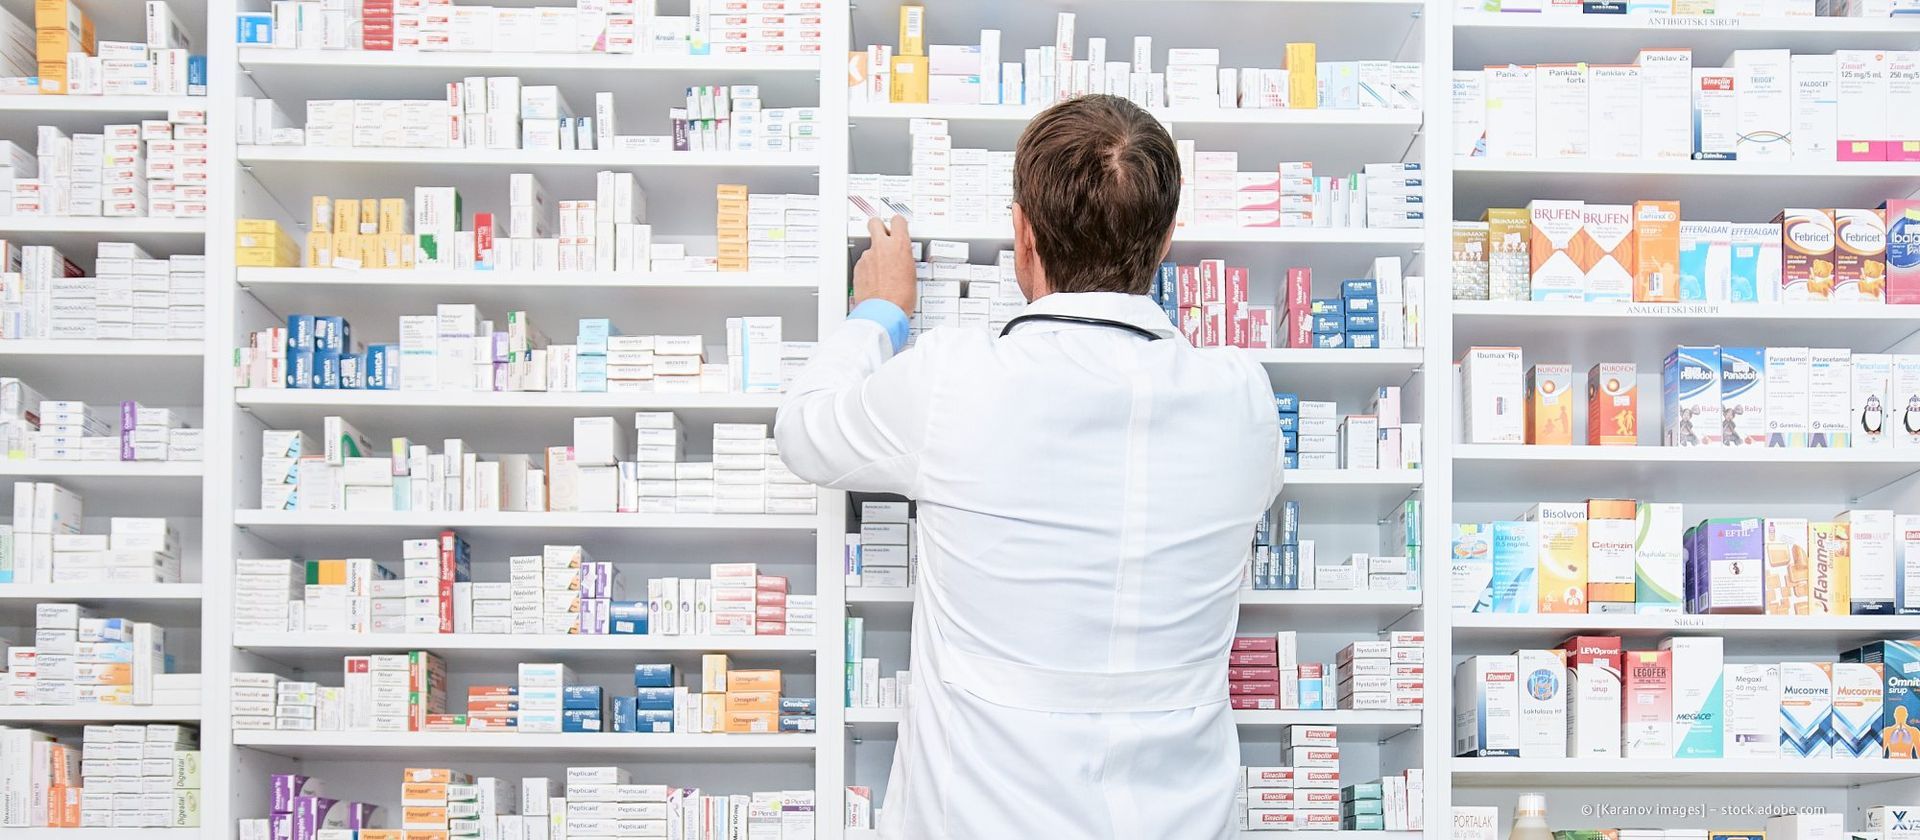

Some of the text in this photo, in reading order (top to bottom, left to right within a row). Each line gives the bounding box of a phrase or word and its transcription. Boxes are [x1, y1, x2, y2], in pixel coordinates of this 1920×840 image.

[1648, 18, 1740, 27] ANTIBIOTSKI SIRUPI
[1549, 69, 1582, 77] Panklav
[1854, 71, 1870, 79] mg/5
[1534, 208, 1581, 220] BRUFEN
[1583, 213, 1630, 225] BRUFEN
[1681, 225, 1727, 234] EFFERALGAN
[1731, 228, 1778, 236] EFFERALGAN
[1794, 232, 1829, 242] Febricet
[1845, 233, 1880, 242] Febricet
[1626, 305, 1719, 315] ANALGETSKI SIRUPI
[1508, 352, 1519, 360] Rp
[1680, 371, 1712, 380] Panadol
[1723, 371, 1755, 380] Panadol
[1277, 397, 1292, 406] loft
[1701, 405, 1719, 414] Baby
[1744, 405, 1762, 414] Baby
[1542, 508, 1584, 519] Bisolvon
[1591, 541, 1633, 549] Cetirizin
[1814, 530, 1828, 613] Flavamed
[1674, 617, 1704, 627] SIRUPI
[1581, 648, 1618, 656] LEVOpront
[1633, 668, 1667, 678] LEGOFER
[1735, 676, 1762, 684] Megoxi
[1784, 686, 1829, 695] MUCODYNE
[1836, 687, 1882, 696] MUCODYNE
[1889, 687, 1908, 695] sirup
[176, 796, 185, 826] Digestal
[1454, 816, 1493, 828] PORTALAK
